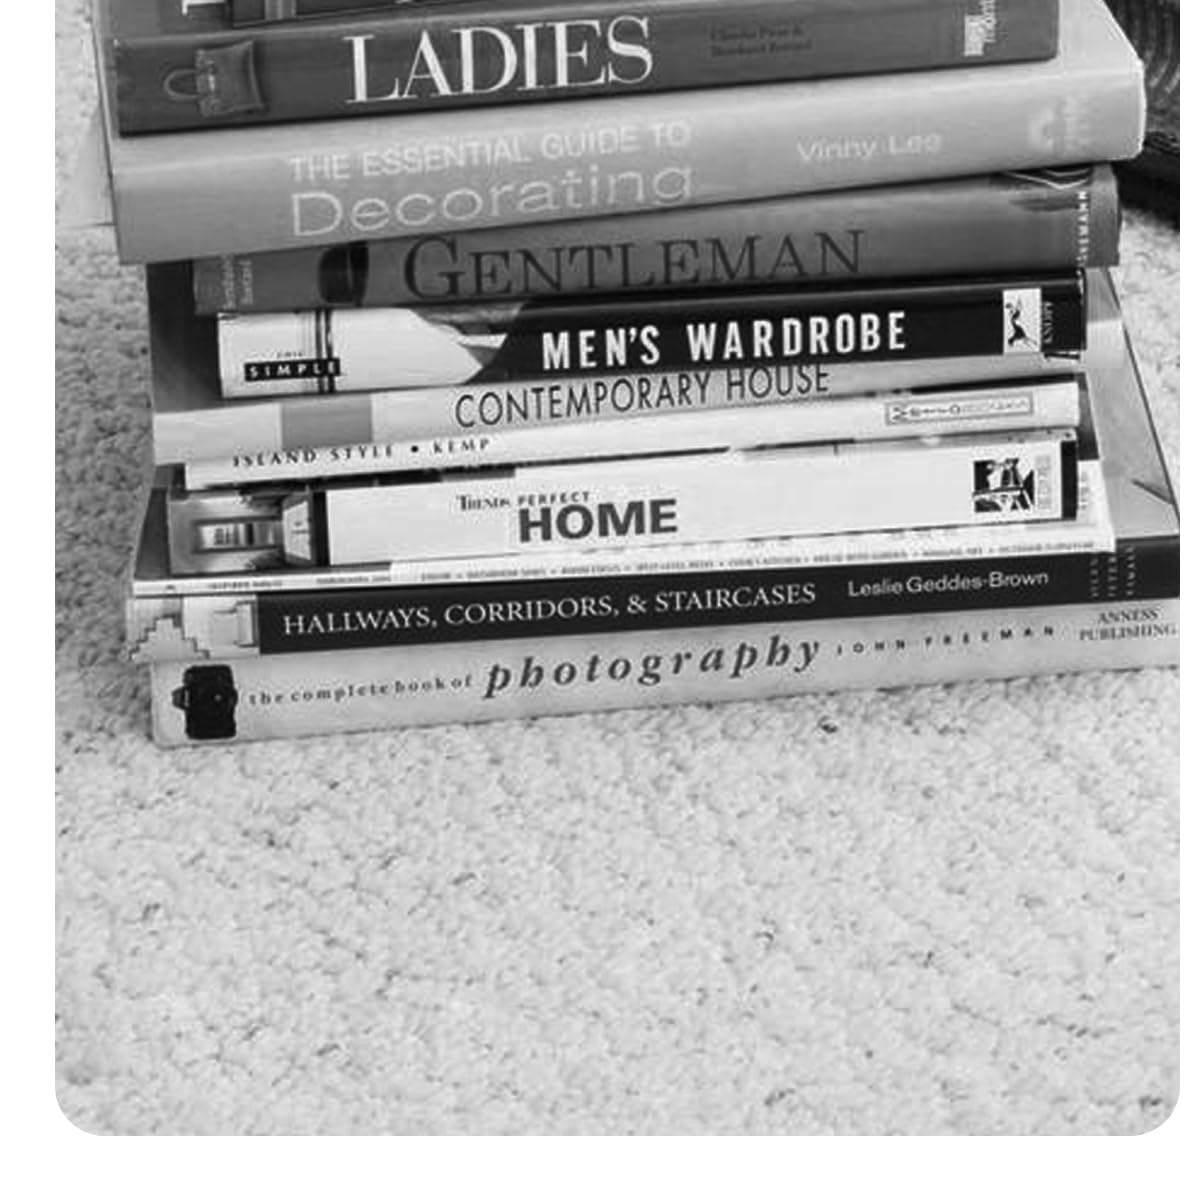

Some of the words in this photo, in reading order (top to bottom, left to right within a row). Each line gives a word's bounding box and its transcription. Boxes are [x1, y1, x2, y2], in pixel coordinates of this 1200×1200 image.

[344, 16, 653, 104] LADIES
[290, 155, 351, 183] THE
[362, 136, 529, 176] ESSENTIAL
[542, 125, 640, 159] GUIDE
[655, 121, 690, 148] TO
[796, 136, 878, 164] Vinny
[888, 131, 944, 157] Lee
[290, 165, 691, 238] Decorating
[404, 230, 866, 300] GENTLEMAN
[542, 327, 660, 370] MEN'S
[687, 311, 907, 358] WARDROBE
[249, 361, 335, 378] SIMPLE
[456, 371, 710, 428] CONTEMPORARY
[727, 364, 829, 400] HOUSE
[233, 447, 317, 467] ISLAND
[330, 445, 394, 461] STYLE
[433, 438, 490, 454] KEMP
[518, 491, 590, 504] PERFECT
[519, 498, 677, 542] HOME
[849, 575, 902, 597] Leslie
[906, 569, 1049, 592] Geddes-Brown
[284, 609, 436, 636] HALLWAYS,
[445, 597, 619, 628] CORRIDORS,
[628, 595, 646, 614] &
[655, 583, 816, 613] STAIRCASES
[1097, 607, 1162, 623] ANNESS
[835, 638, 907, 655] JOHN
[923, 625, 1056, 647] FREEMAN
[1079, 622, 1178, 642] PUBLISHING
[484, 634, 819, 700] photography
[248, 688, 284, 706] the
[290, 684, 389, 703] complete
[395, 677, 445, 693] book
[451, 674, 472, 688] of
